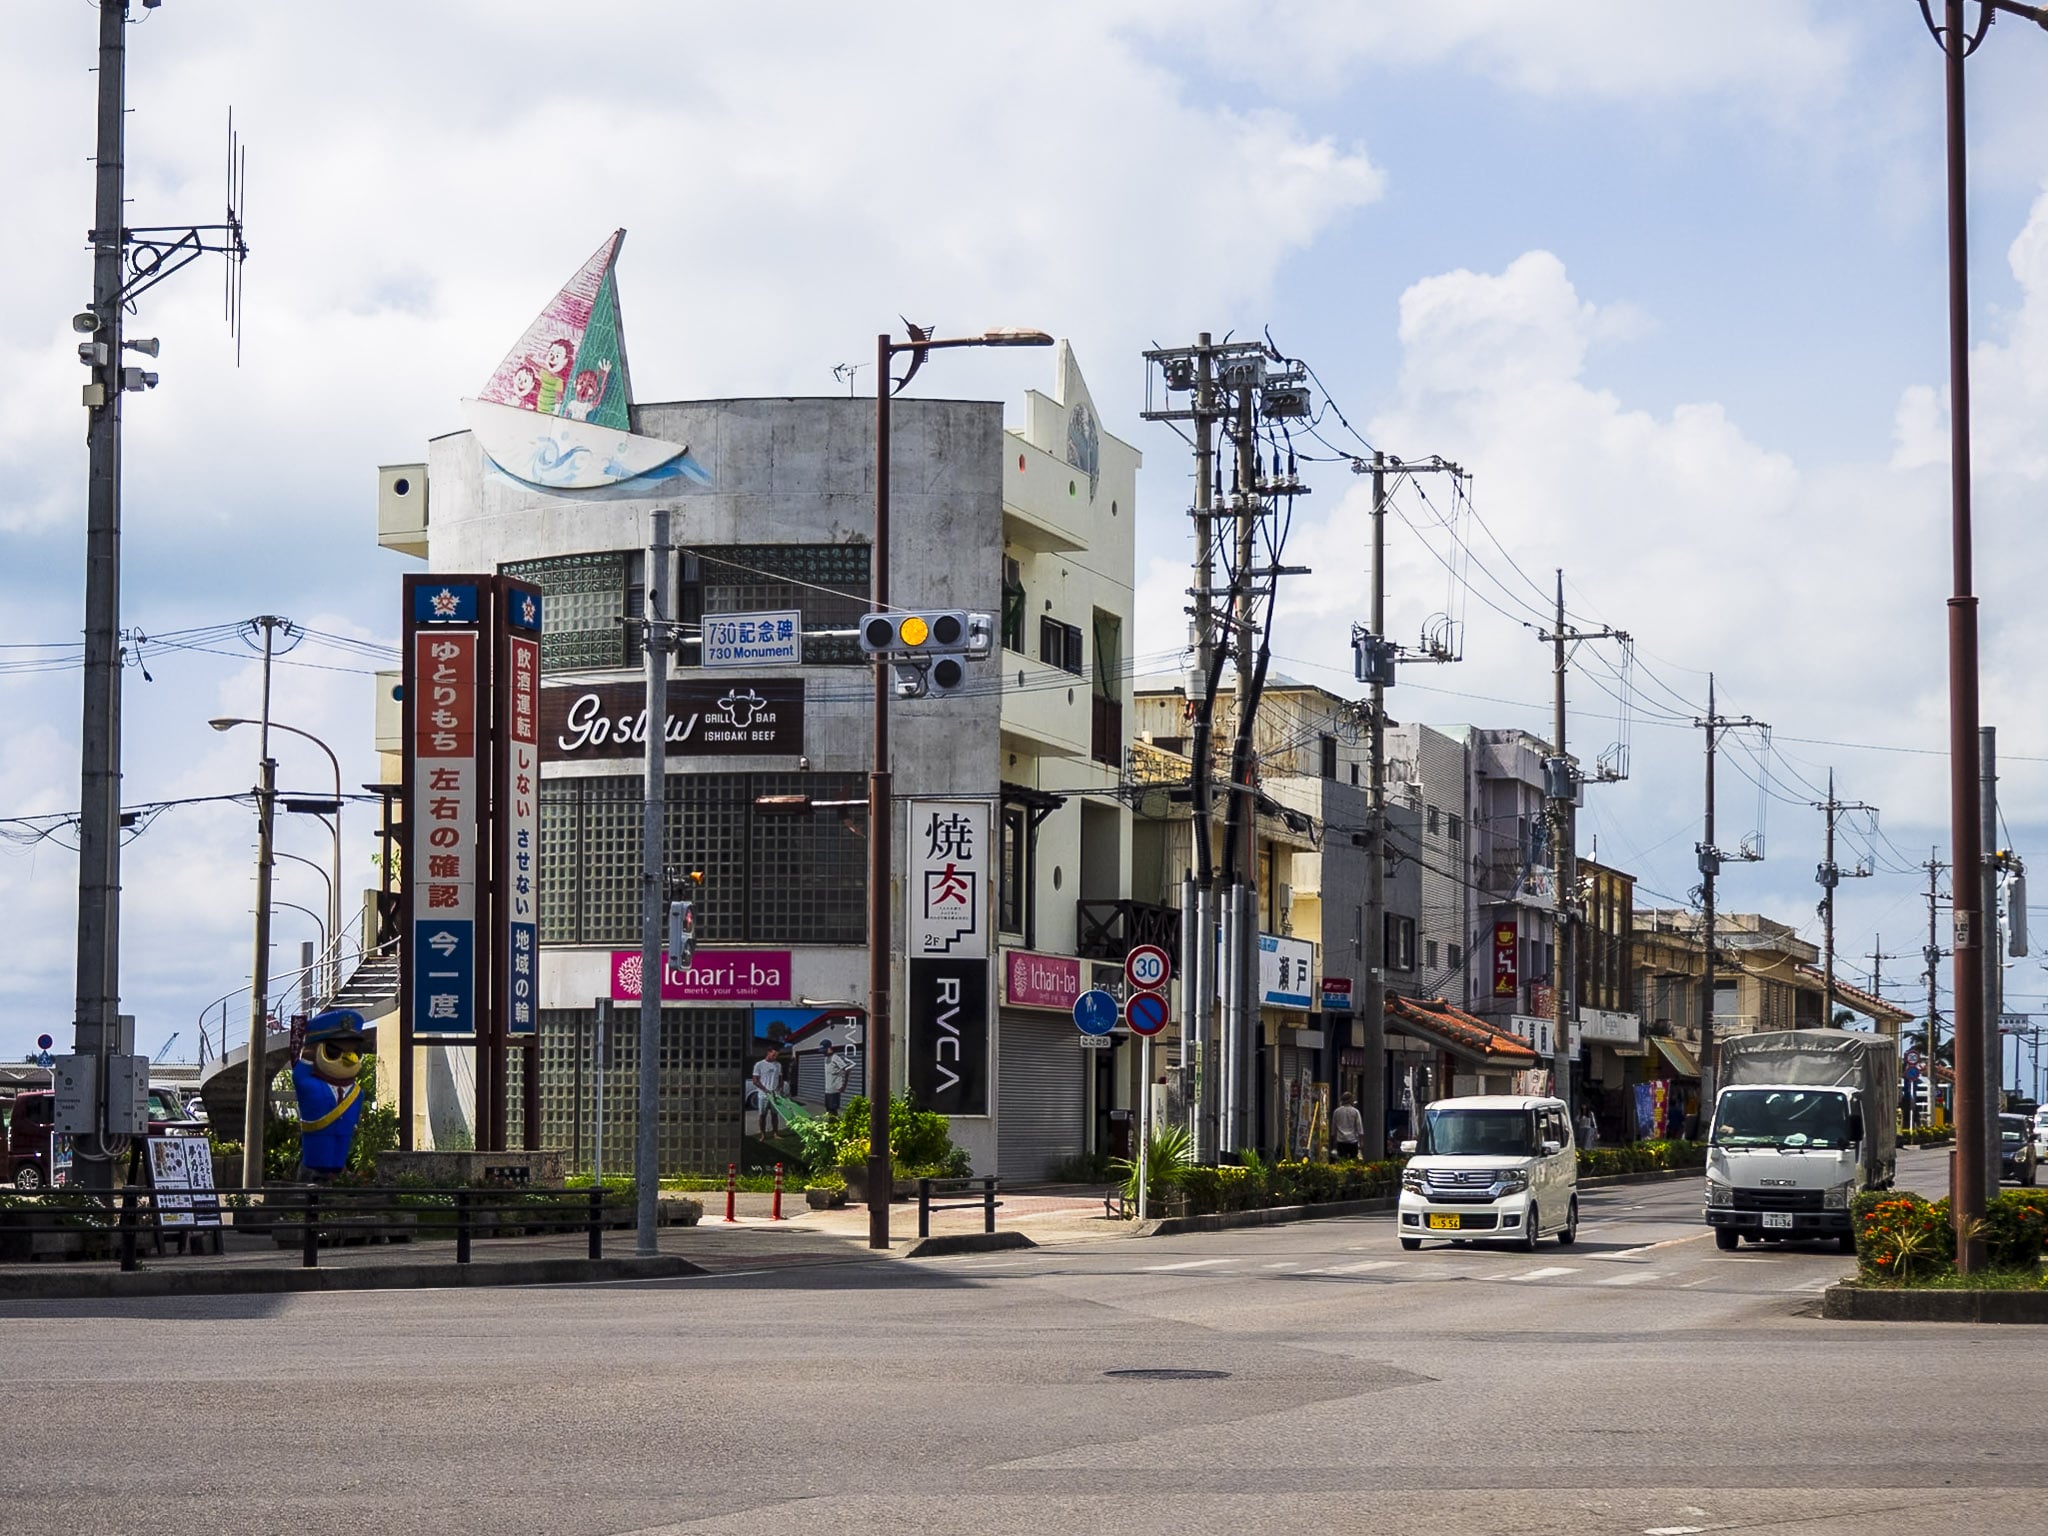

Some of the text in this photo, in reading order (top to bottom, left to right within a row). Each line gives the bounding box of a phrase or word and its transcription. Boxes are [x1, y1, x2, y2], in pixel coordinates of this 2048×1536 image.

[708, 618, 794, 646] 730記念碑
[709, 644, 794, 660] 730 Monument
[705, 712, 777, 724] GRILL BAR
[704, 731, 776, 741] ISHIGAKI BEEF
[428, 641, 461, 1019] ゆとりもち 左右の確認 今一度
[515, 647, 532, 1024] 飲酒運転 しない させない 地域の輪
[924, 812, 976, 932] 焼肉
[924, 934, 940, 947] 2F
[1031, 962, 1076, 994] Ichari-ba
[1135, 958, 1161, 978] 30
[684, 987, 709, 995] meets
[713, 988, 732, 996] your
[844, 1015, 857, 1072] RVCA
[936, 977, 961, 1094] RVCA
